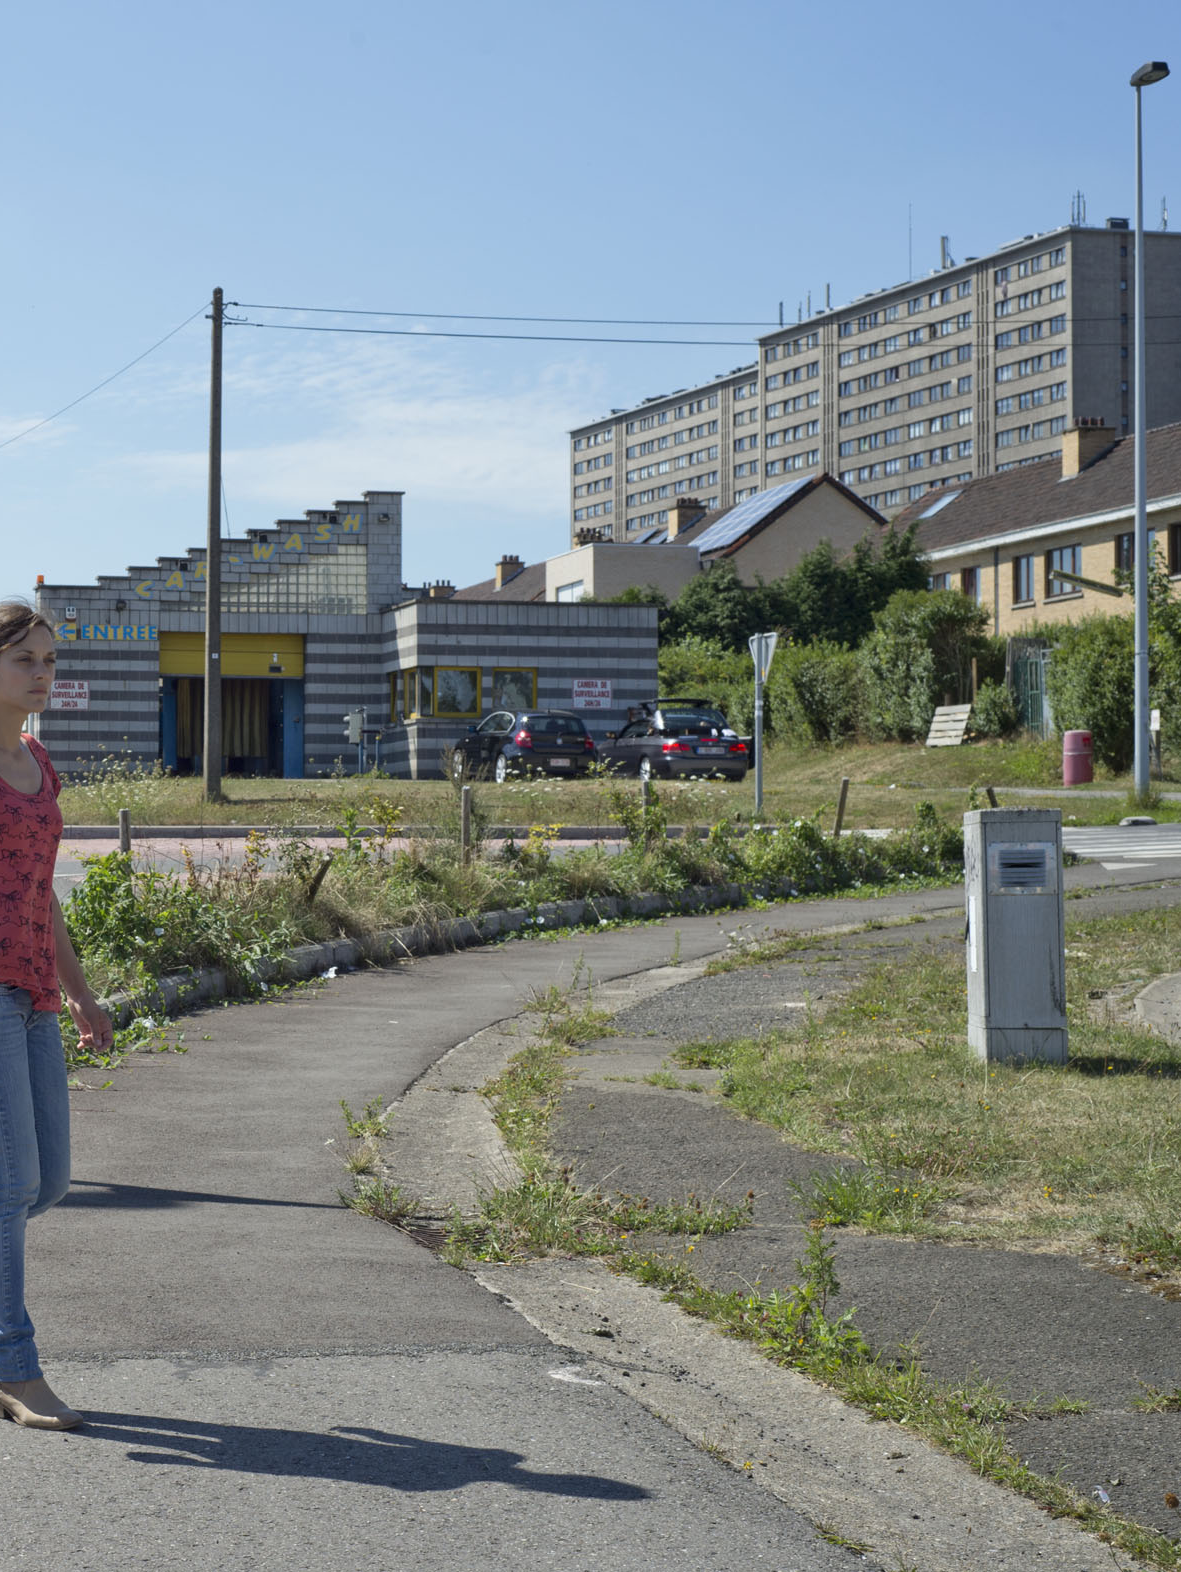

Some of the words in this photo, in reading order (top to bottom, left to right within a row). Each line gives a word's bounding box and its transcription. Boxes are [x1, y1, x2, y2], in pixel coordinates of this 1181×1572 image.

[81, 624, 157, 640] ENTREE
[54, 682, 75, 690] CAMERA
[77, 682, 84, 690] DE
[577, 681, 598, 689] CAMERA
[52, 691, 87, 699] SURVEILLANCE
[575, 690, 610, 698] SURVEILLANCE
